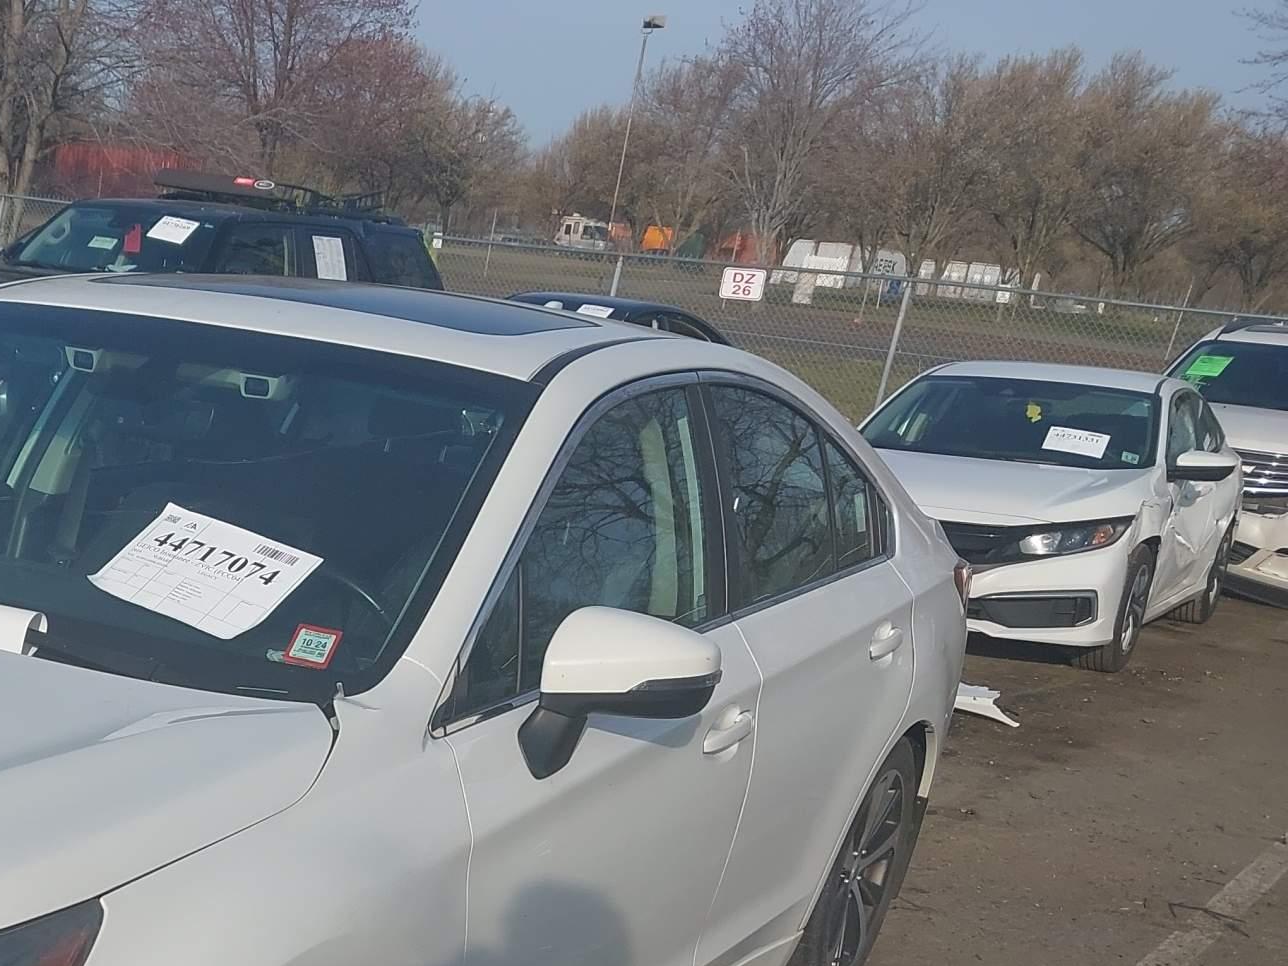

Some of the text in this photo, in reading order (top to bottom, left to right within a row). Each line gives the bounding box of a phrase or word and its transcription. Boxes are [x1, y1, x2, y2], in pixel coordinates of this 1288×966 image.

[732, 272, 756, 284] DZ
[731, 284, 752, 296] 26
[136, 541, 161, 553] GEICO
[153, 532, 281, 585] 44717074
[302, 638, 328, 649] 10 24
